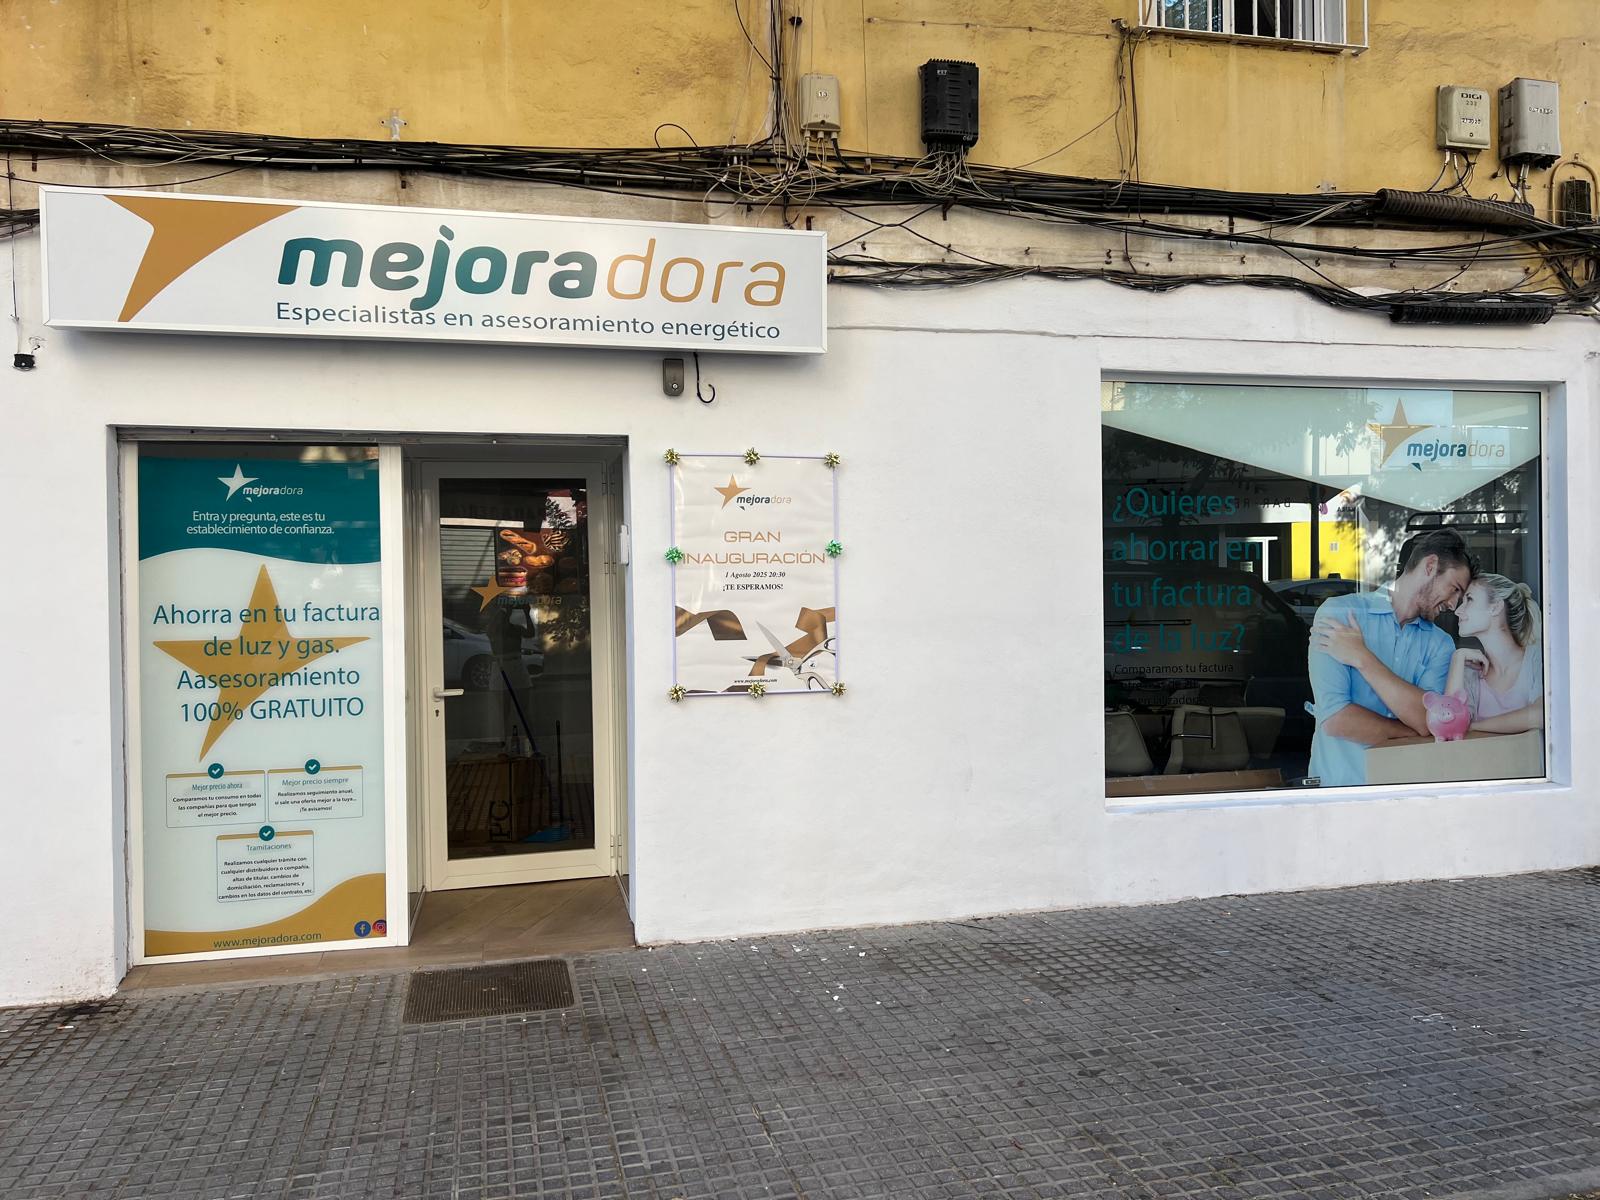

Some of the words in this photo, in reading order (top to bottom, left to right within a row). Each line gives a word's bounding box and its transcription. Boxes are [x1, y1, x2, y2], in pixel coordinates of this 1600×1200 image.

[1460, 92, 1483, 100] DIGI
[277, 224, 787, 311] mejoradora
[276, 301, 437, 327] Especialistas
[443, 310, 474, 327] en
[481, 312, 655, 333] asesoramiento
[661, 318, 781, 341] energético
[1406, 439, 1506, 463] mejoradora
[242, 484, 304, 498] mejoradora
[736, 494, 792, 506] mejoradora
[1111, 487, 1236, 523] ¿Quieres
[193, 510, 220, 522] Entra
[221, 514, 228, 525] y
[229, 512, 279, 525] pregunta,
[280, 512, 302, 522] este
[302, 513, 313, 522] es
[314, 512, 326, 522] tu
[186, 524, 268, 535] establecimiento
[269, 524, 283, 535] de
[284, 523, 335, 535] confianza.
[724, 531, 781, 543] GRAN
[1112, 532, 1219, 561] ahorrar
[1226, 541, 1261, 561] en
[682, 550, 826, 564] INAUGURACIÓN
[730, 571, 751, 579] Agosto
[722, 583, 735, 592] ¡TE
[736, 583, 784, 591] ESPERAMOS!
[1112, 580, 1143, 608] tu
[1151, 577, 1253, 608] factura
[153, 604, 232, 625] Ahorra
[239, 608, 266, 623] en
[275, 603, 297, 623] tu
[303, 601, 381, 623] factura
[1112, 623, 1150, 654] de
[1160, 623, 1182, 652] la
[1191, 623, 1247, 652] luz?
[203, 636, 233, 656] de
[239, 635, 272, 655] luz
[278, 640, 291, 660] y
[296, 639, 340, 659] gas.
[1114, 664, 1184, 675] Comparamos
[1186, 664, 1196, 673] tu
[1199, 662, 1234, 673] factura
[177, 667, 361, 689] Aasesoramiento
[181, 701, 244, 722] 100%
[250, 696, 364, 720] GRATUITO
[191, 783, 208, 792] Mejor
[209, 783, 226, 792] precio
[227, 782, 243, 790] ahora
[282, 779, 301, 787] Mejor
[302, 778, 322, 787] precio
[323, 777, 350, 786] siempre
[246, 843, 292, 852] Tramitaciones
[213, 931, 322, 949] www.mejoradora.com
